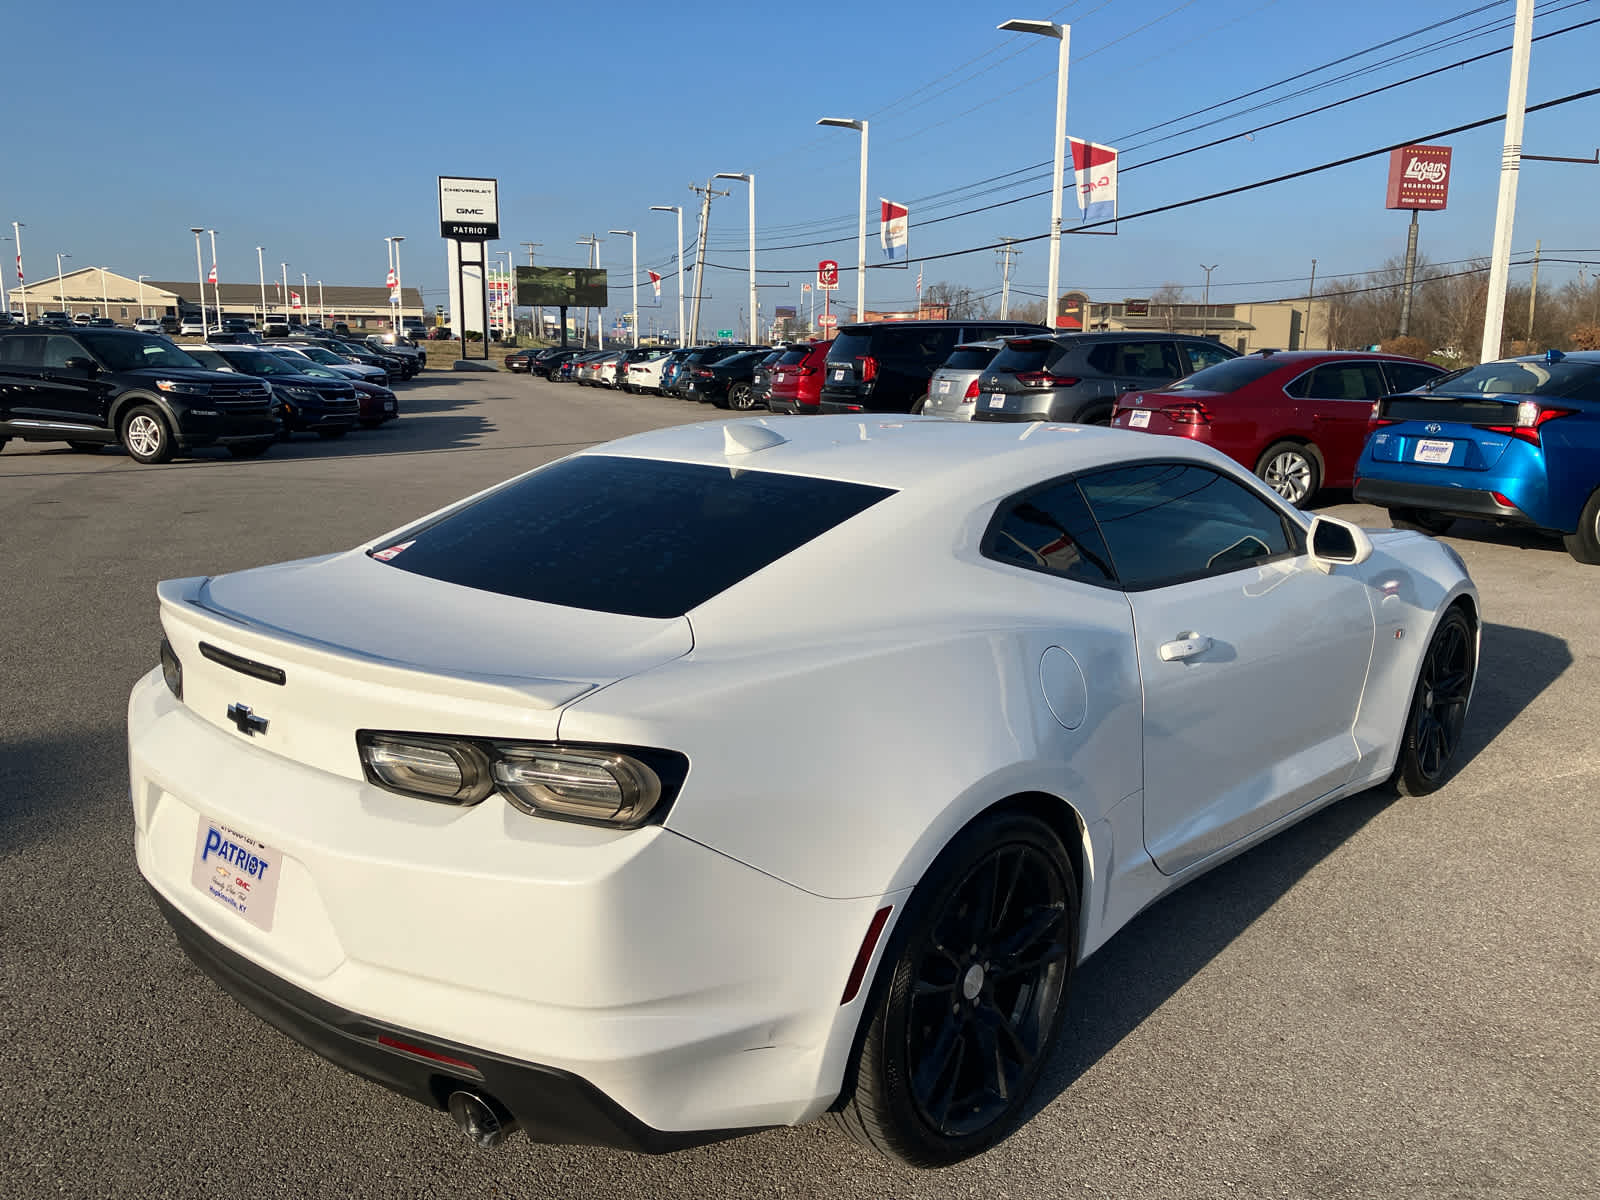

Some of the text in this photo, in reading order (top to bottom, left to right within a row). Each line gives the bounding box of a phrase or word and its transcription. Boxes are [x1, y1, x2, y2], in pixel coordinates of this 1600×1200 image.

[453, 226, 487, 235] PATRIOT
[202, 827, 268, 880] PATRIOT
[235, 877, 251, 892] GMC
[239, 904, 247, 913] KY
